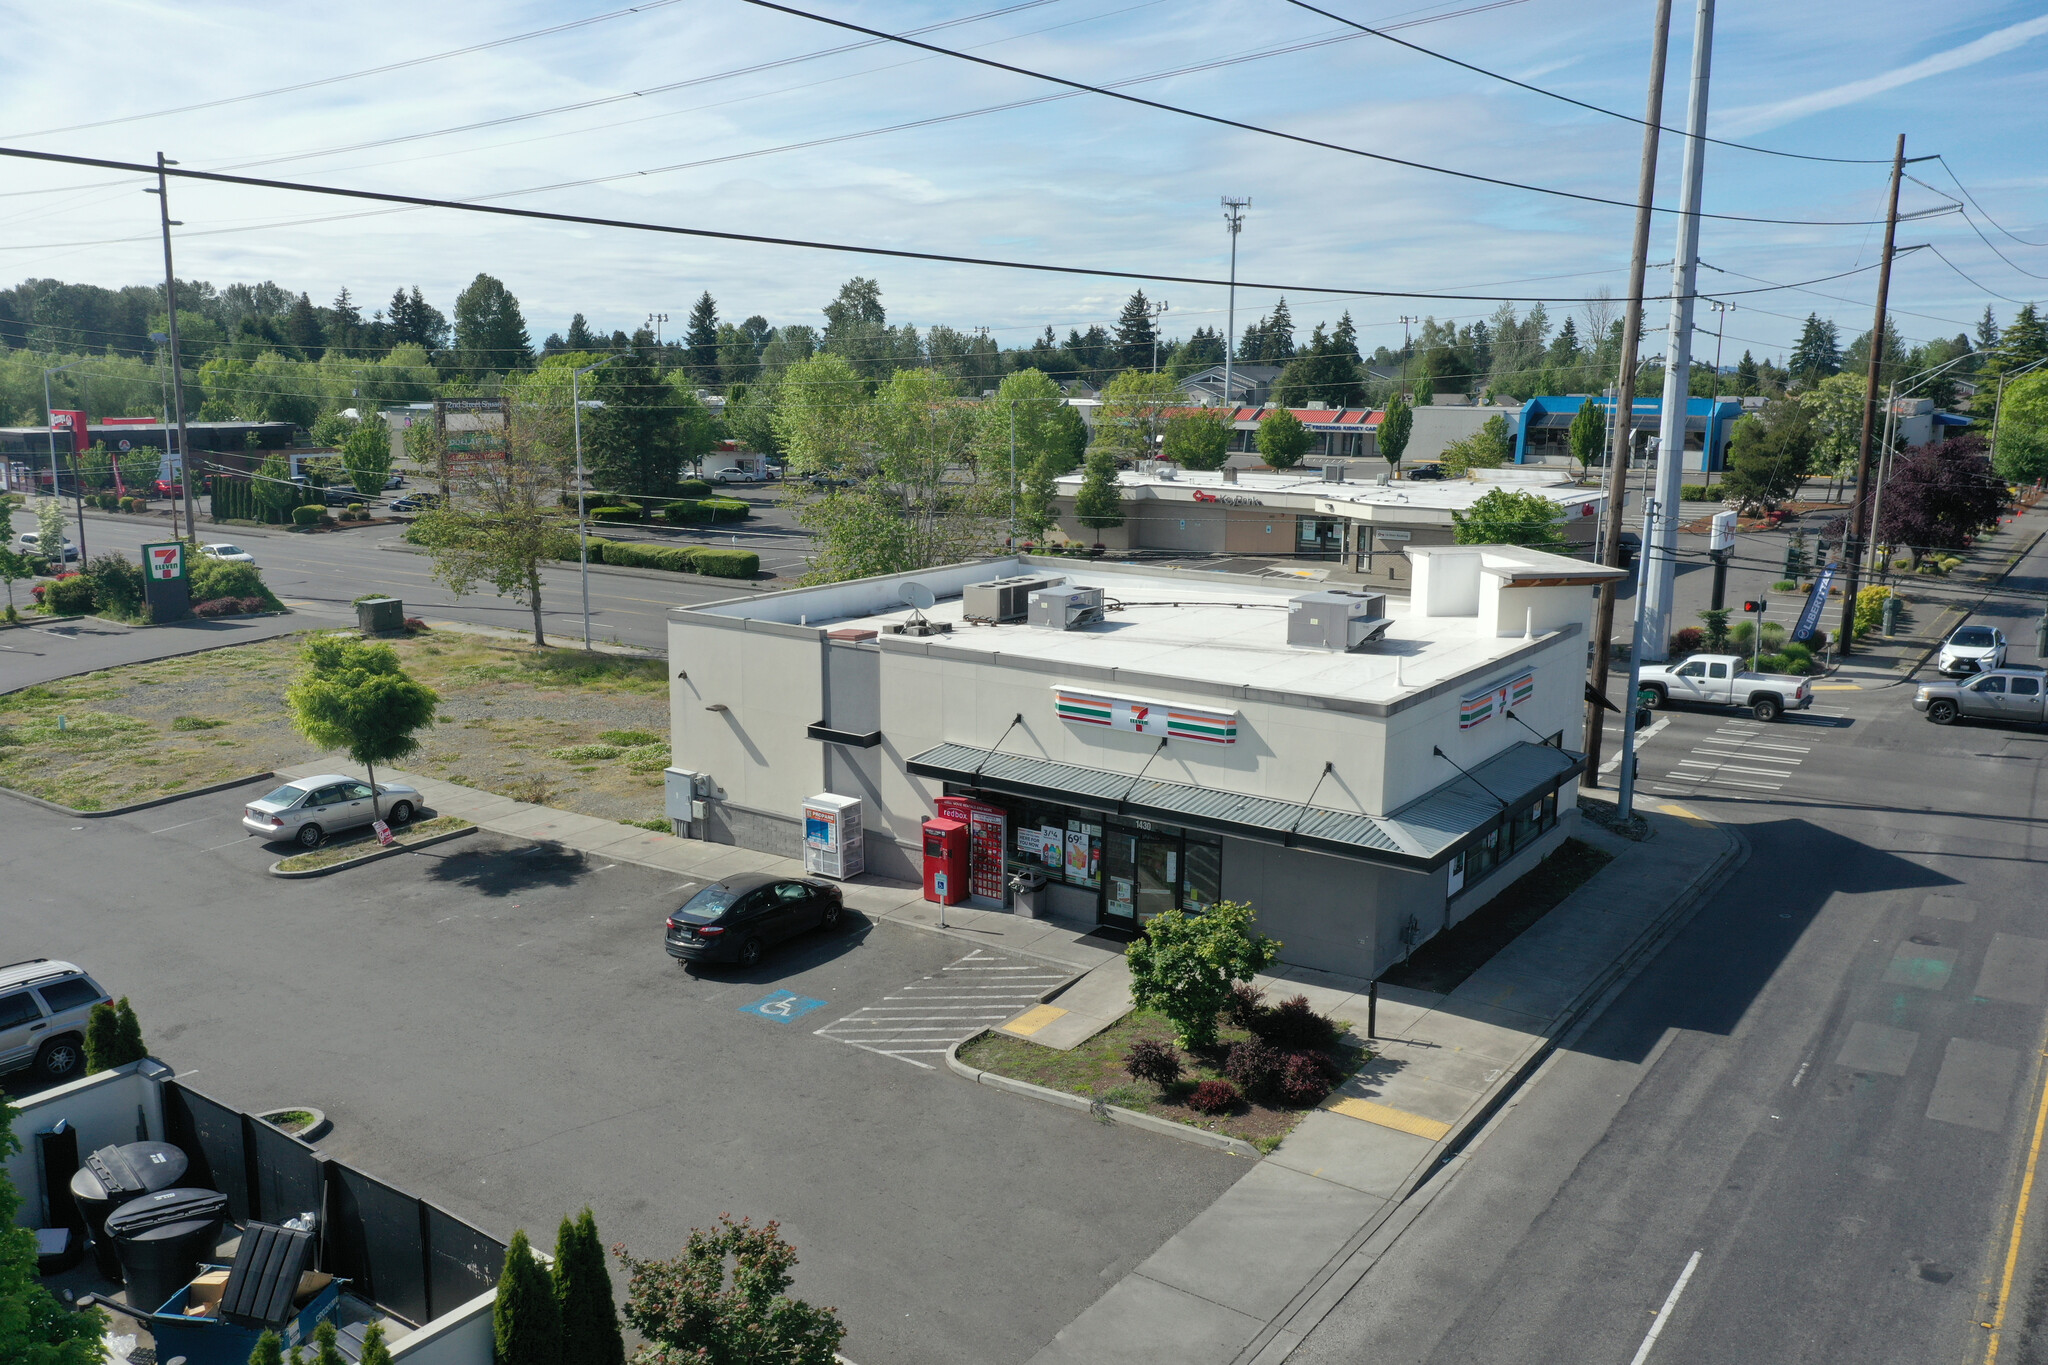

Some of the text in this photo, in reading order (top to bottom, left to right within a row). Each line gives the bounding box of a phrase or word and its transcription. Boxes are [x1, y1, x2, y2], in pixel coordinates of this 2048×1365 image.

[1219, 494, 1260, 506] KeyBank
[812, 811, 834, 820] PROPANE
[943, 809, 967, 819] redbox
[1135, 820, 1151, 830] 1430
